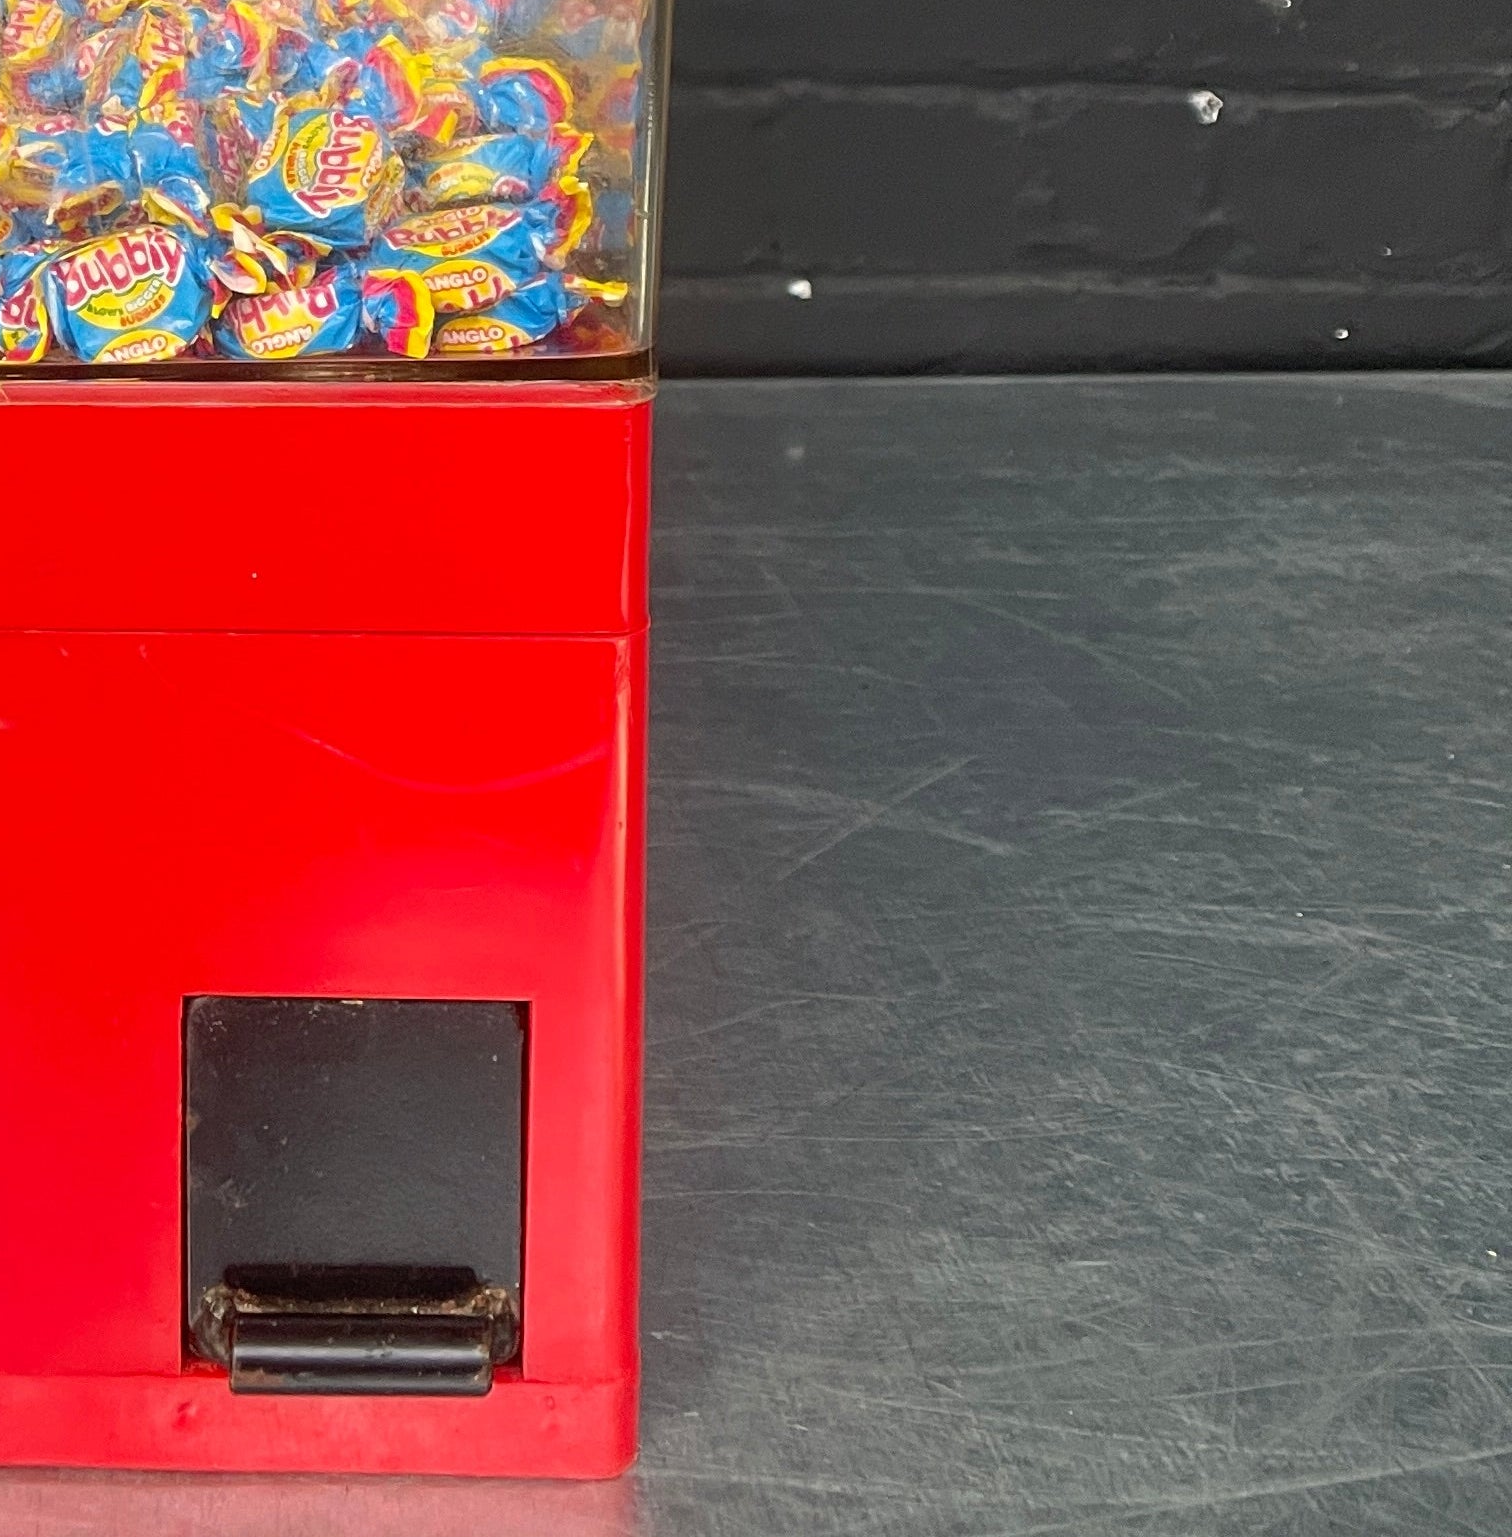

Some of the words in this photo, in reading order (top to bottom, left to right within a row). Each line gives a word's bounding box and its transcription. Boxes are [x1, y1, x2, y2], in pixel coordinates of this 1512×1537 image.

[292, 112, 377, 218] Bubbly
[49, 226, 187, 310] Bubbly
[424, 267, 489, 292] ANGLO
[119, 294, 166, 327] BUBBLES
[125, 279, 163, 314] BIGGER
[100, 333, 168, 364] ANGLO
[252, 325, 313, 355] ANGLO
[441, 327, 505, 345] ANGLO
